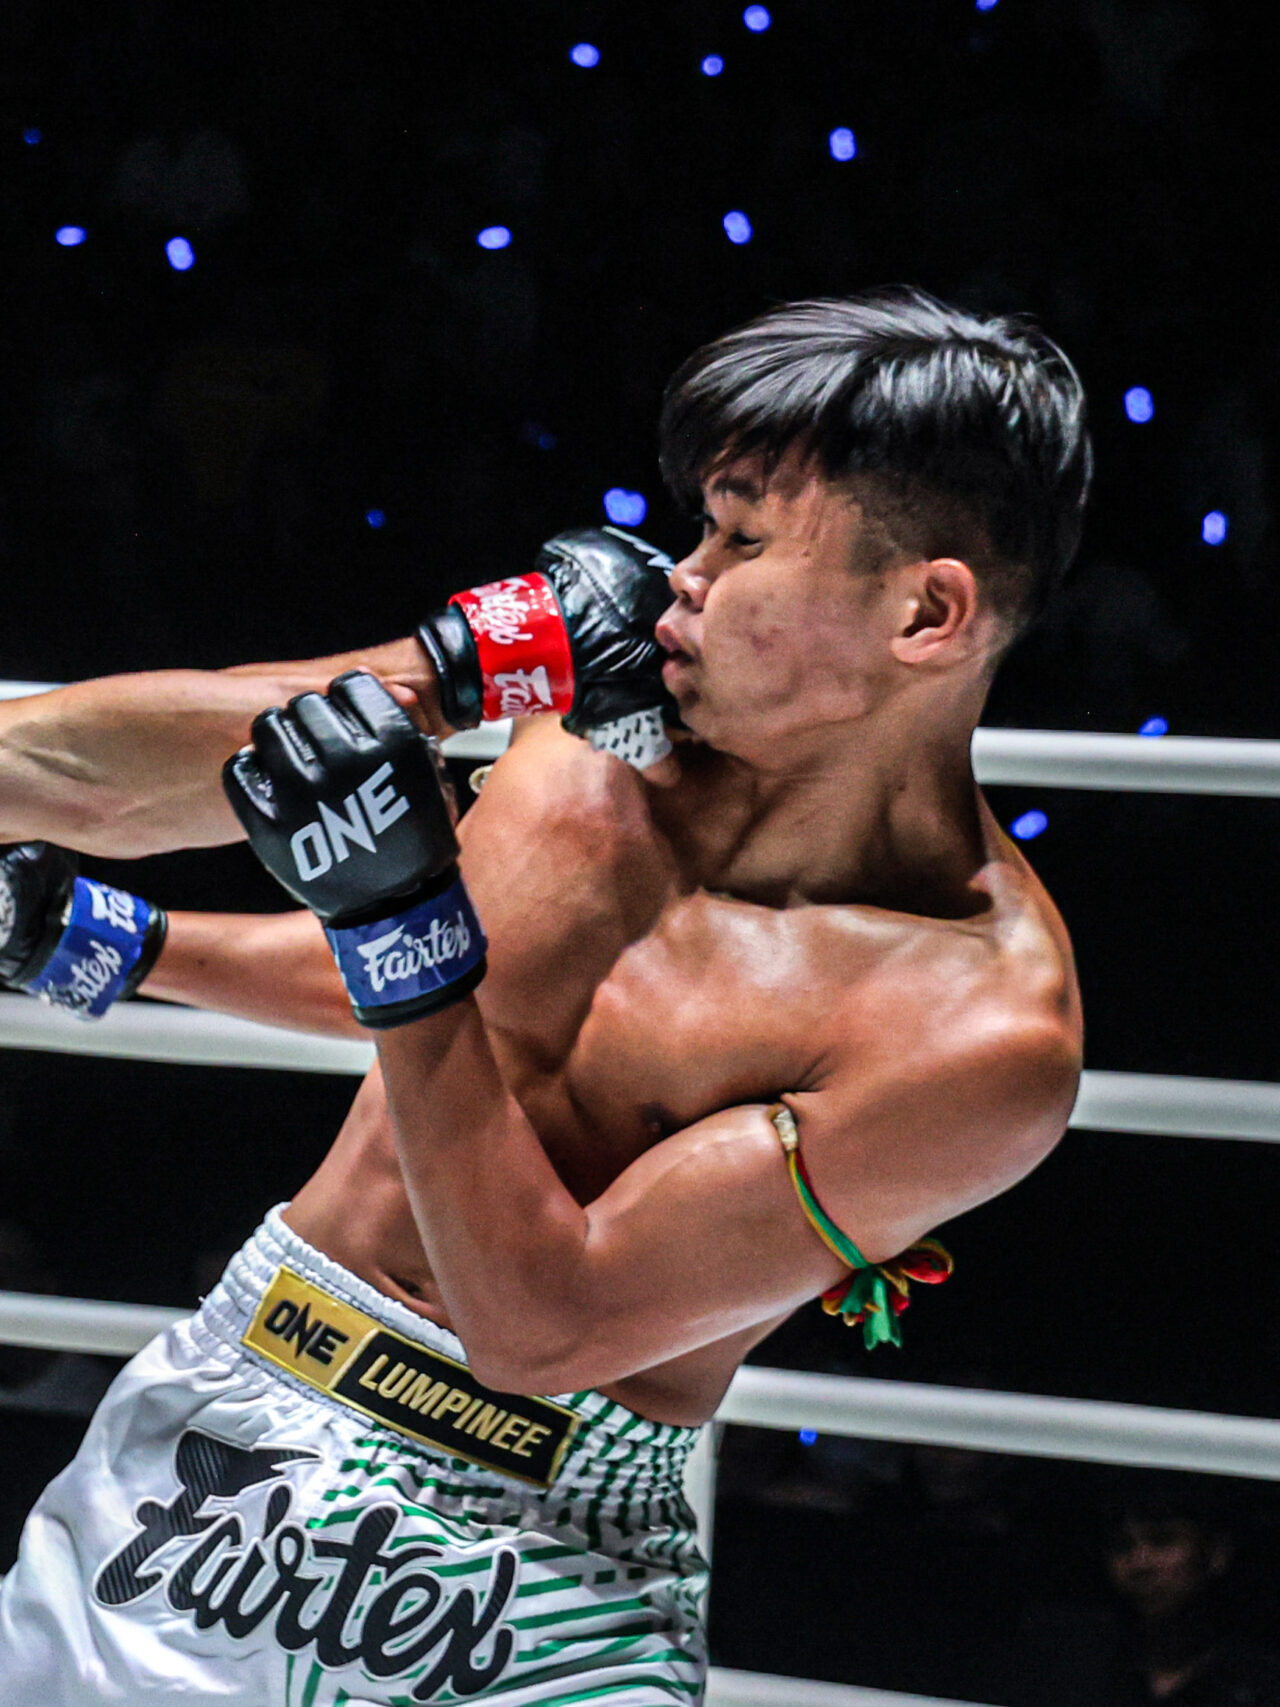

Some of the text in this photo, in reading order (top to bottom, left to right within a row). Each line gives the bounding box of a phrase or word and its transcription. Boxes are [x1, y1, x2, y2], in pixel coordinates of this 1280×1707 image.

[290, 762, 410, 882] ONE
[356, 910, 471, 992] Fairtex
[263, 1299, 552, 1457] ONE LUMPINEE
[94, 1429, 521, 1700] Fairtex
